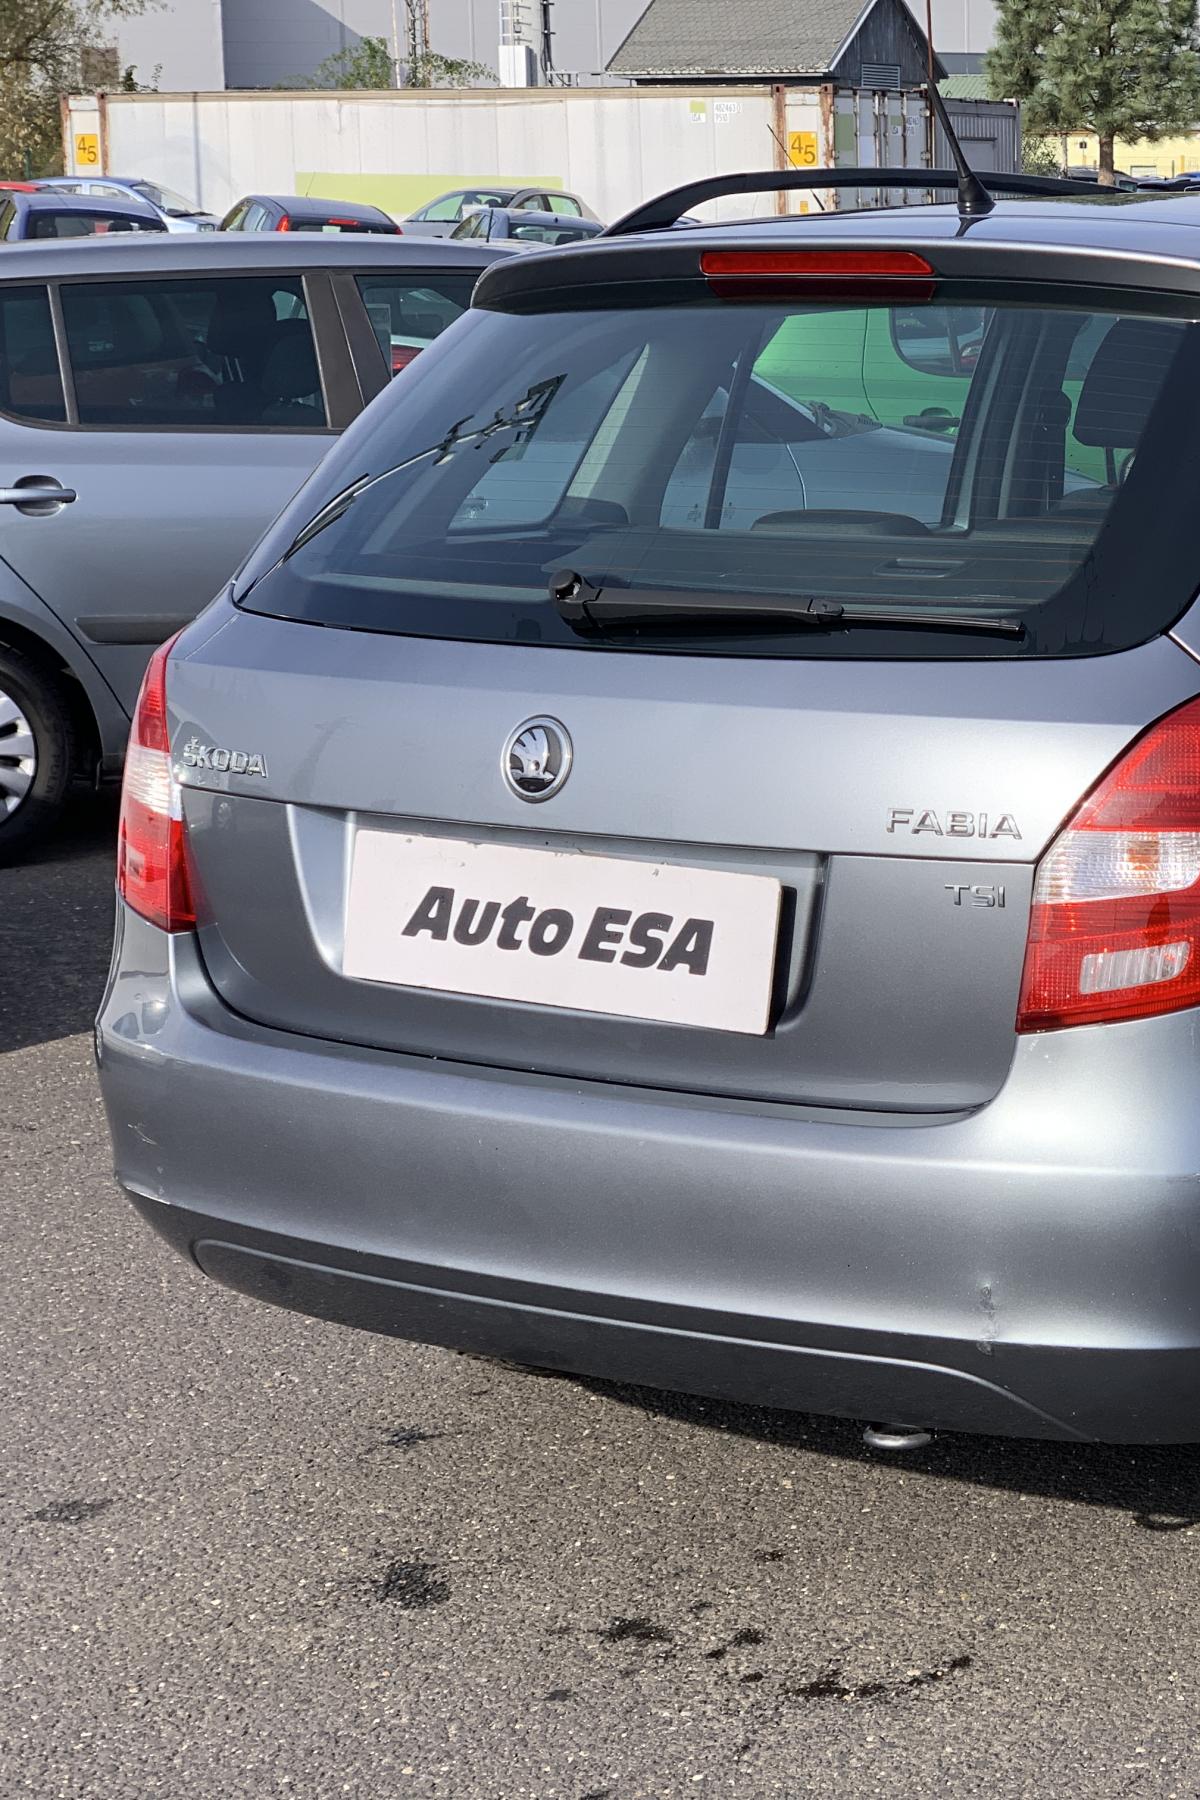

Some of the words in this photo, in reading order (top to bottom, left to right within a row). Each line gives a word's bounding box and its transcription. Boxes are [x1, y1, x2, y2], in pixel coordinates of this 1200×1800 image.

[77, 136, 97, 163] 45
[790, 134, 816, 165] 45
[180, 736, 269, 779] ŠKODA
[886, 807, 1023, 840] FABIA
[944, 884, 1006, 908] TSI
[401, 885, 575, 957] Auto
[577, 906, 716, 977] ESA
